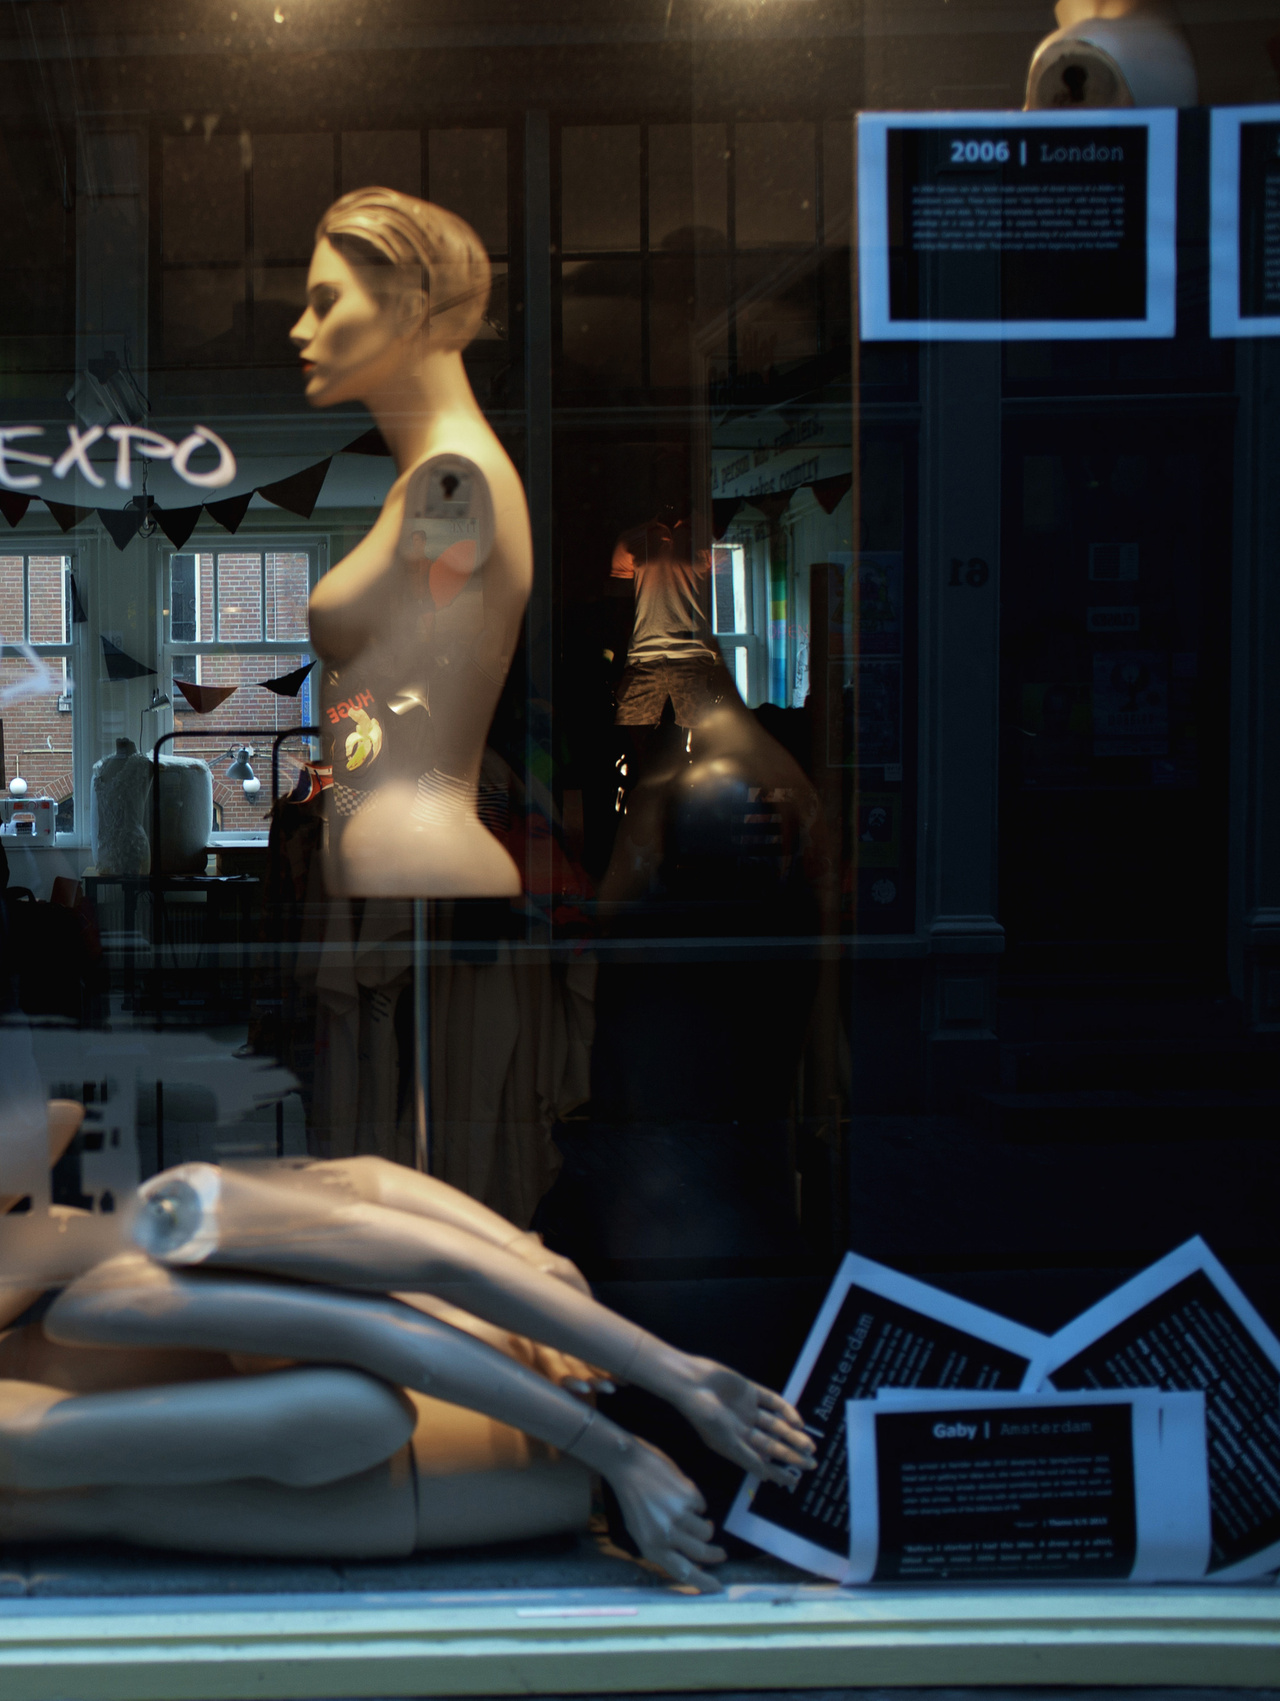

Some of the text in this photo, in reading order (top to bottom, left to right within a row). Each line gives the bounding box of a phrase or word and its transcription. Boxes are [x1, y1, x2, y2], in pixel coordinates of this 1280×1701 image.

[949, 139, 1124, 164] 2006 London
[813, 1312, 874, 1422] Amsterdam
[931, 1419, 1092, 1441] Gaby Amsterdam
